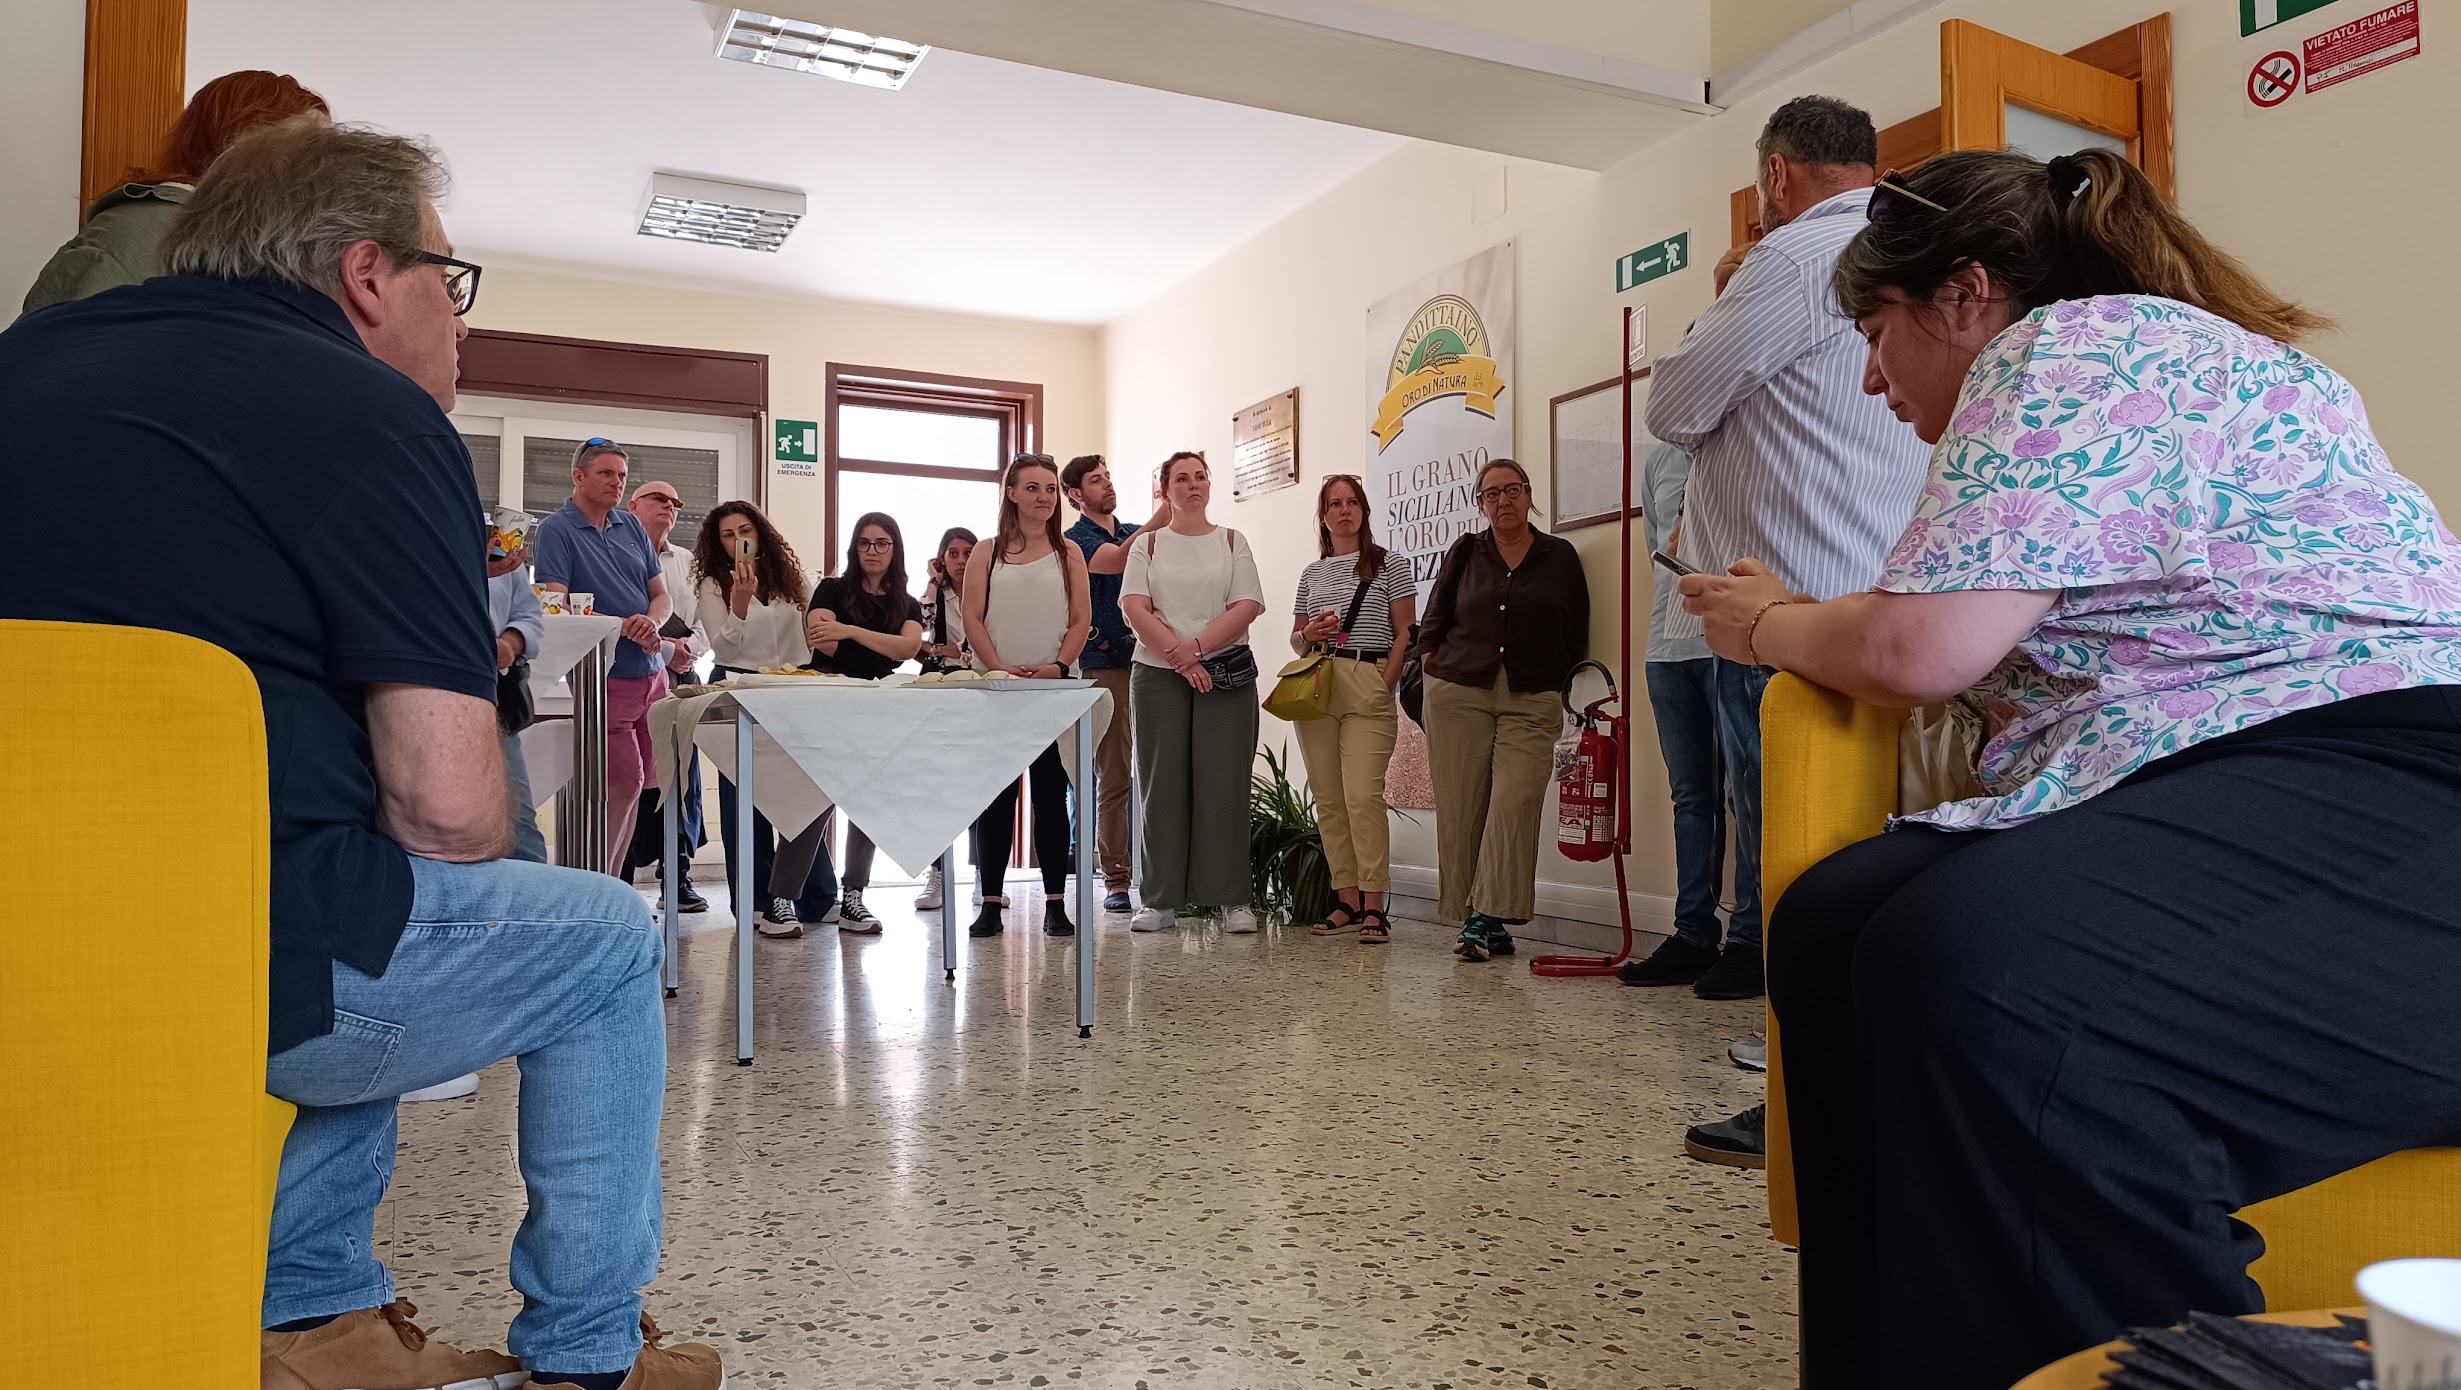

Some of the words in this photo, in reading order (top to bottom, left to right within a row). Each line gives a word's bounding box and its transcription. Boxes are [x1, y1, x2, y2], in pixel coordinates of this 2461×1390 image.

[2306, 24, 2357, 51] VIETATO
[2360, 1, 2415, 30] FUMARE
[1396, 305, 1478, 374] PANDITTAINO
[1402, 387, 1422, 408] ORO
[1422, 384, 1431, 395] DI
[1432, 375, 1467, 392] NATURA
[777, 469, 816, 477] EMERGENZA
[1387, 471, 1407, 499] IL
[1412, 447, 1489, 492] GRANO
[1388, 517, 1450, 553] L'ORO
